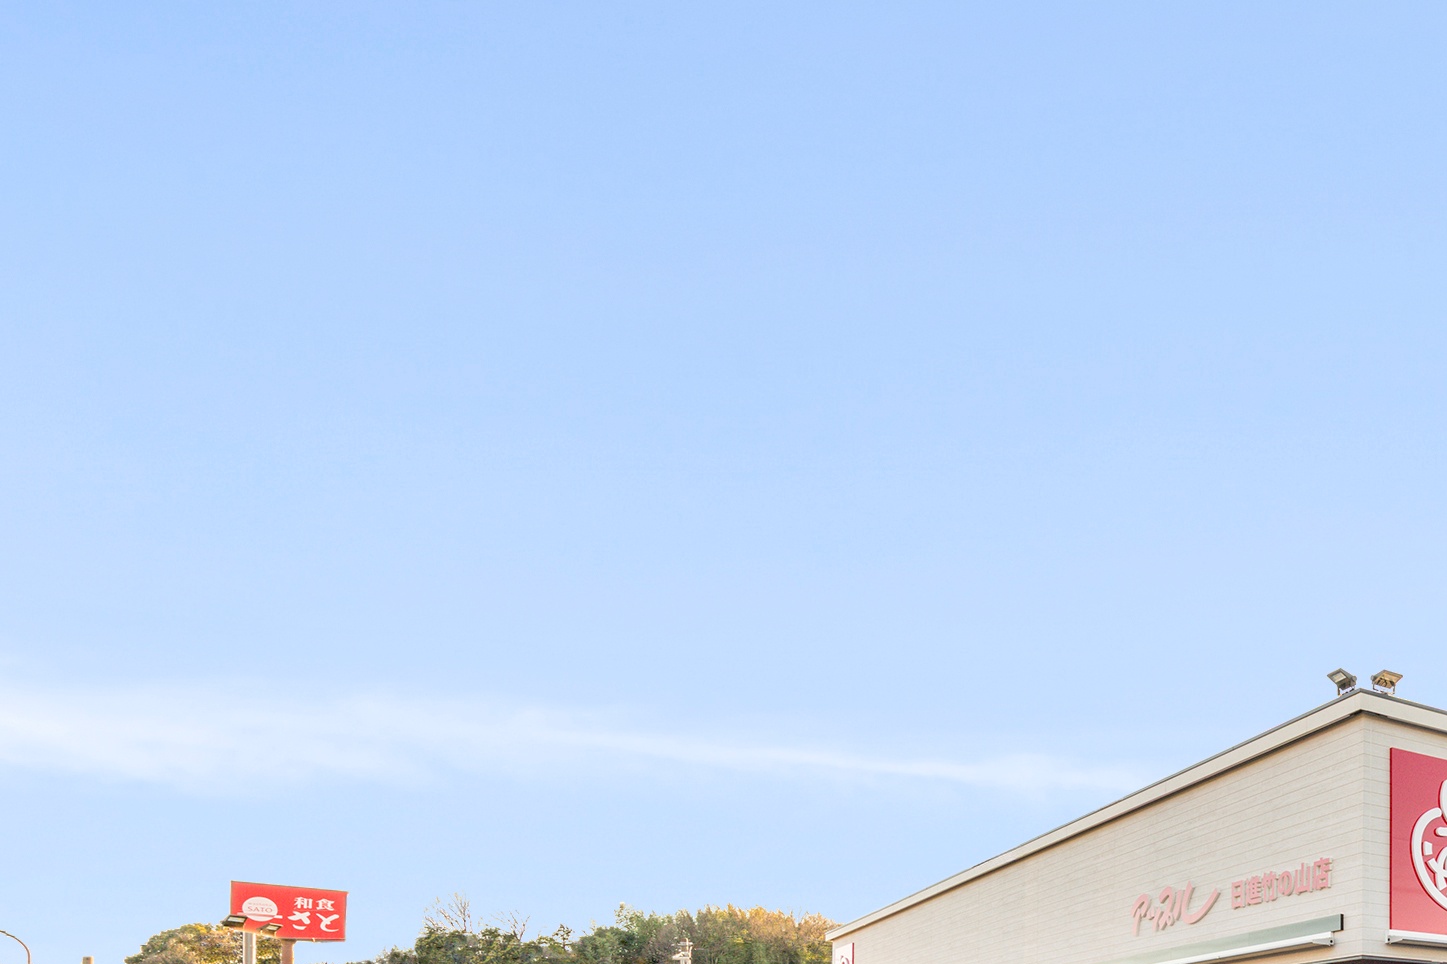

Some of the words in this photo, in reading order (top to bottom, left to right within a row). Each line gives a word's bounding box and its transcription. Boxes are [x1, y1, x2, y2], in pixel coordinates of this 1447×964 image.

[1231, 857, 1334, 910] 日進竹の山店
[287, 911, 340, 932] さと
[294, 897, 335, 911] 和食
[1130, 880, 1221, 937] アップル
